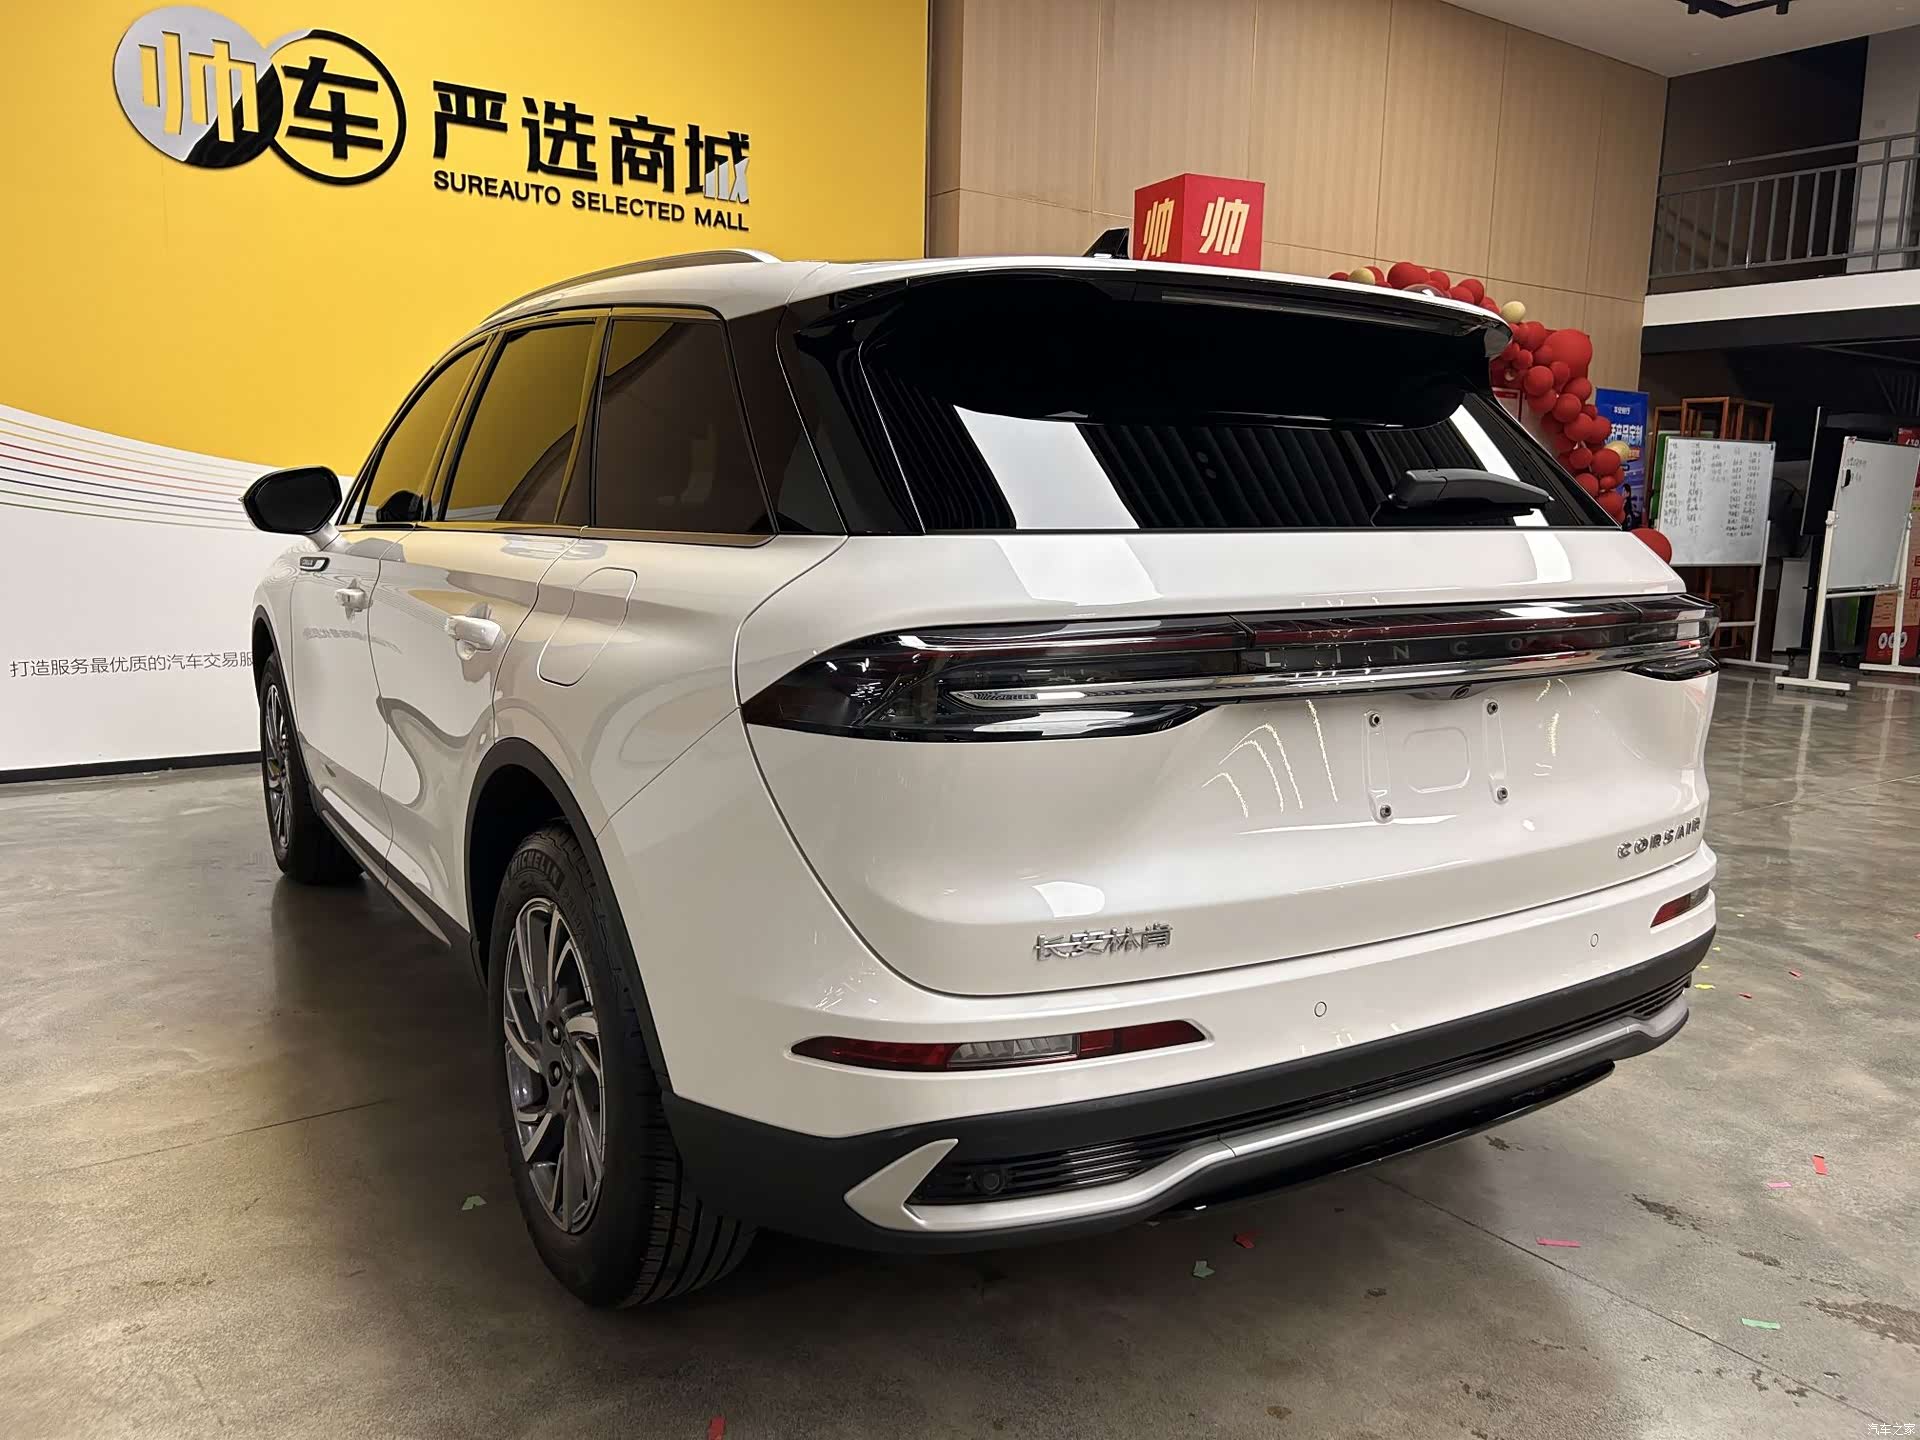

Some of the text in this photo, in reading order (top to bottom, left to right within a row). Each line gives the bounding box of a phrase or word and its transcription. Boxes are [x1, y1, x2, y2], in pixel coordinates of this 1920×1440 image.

[432, 79, 750, 203] 严选商城
[433, 169, 749, 232] SUREAUTO SELECTED MALL
[1617, 816, 1701, 859] CORSAIR
[1033, 922, 1173, 961] 长安林肯
